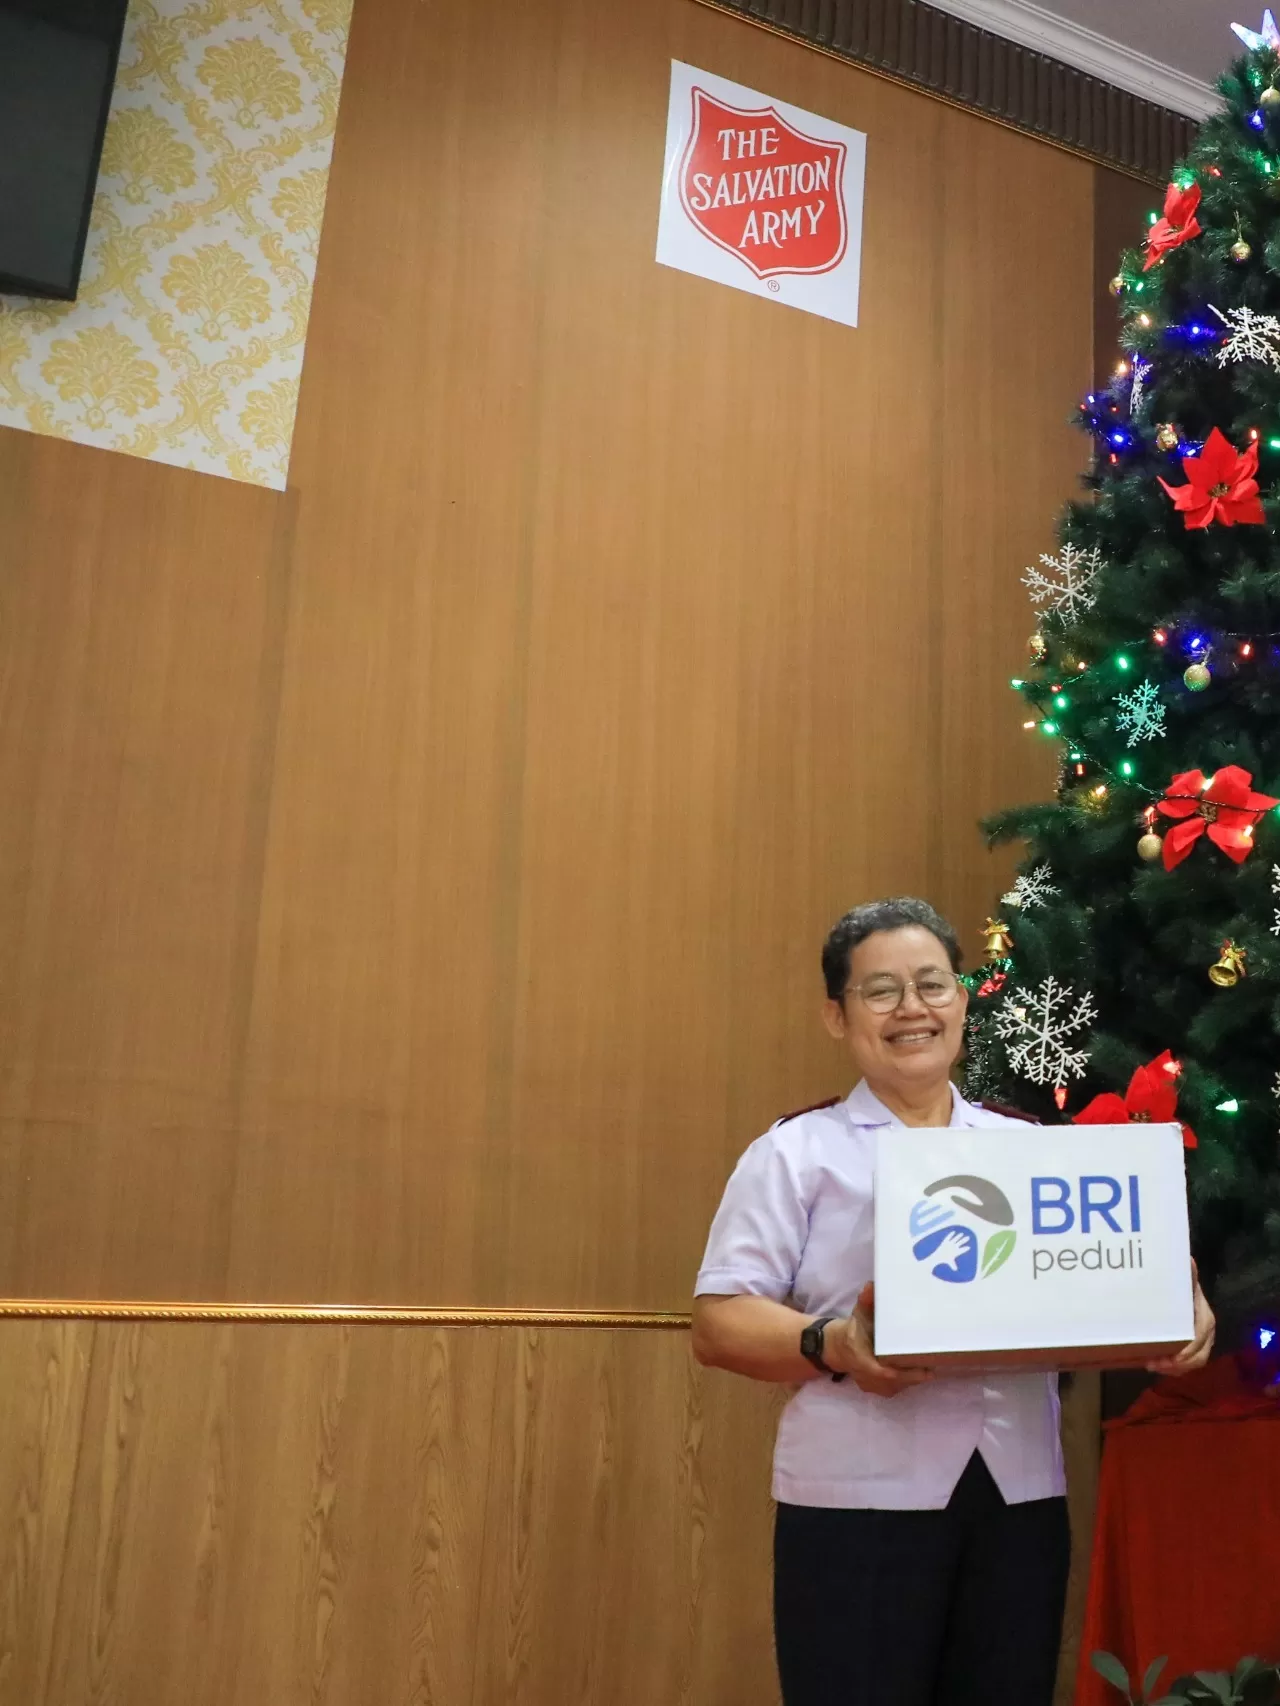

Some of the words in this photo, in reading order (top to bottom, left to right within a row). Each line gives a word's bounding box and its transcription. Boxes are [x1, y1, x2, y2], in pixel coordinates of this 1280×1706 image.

[717, 127, 779, 161] THE
[690, 155, 831, 211] SALVATION
[738, 199, 825, 248] ARMY
[1030, 1175, 1142, 1235] BRI
[1032, 1239, 1143, 1280] peduli
